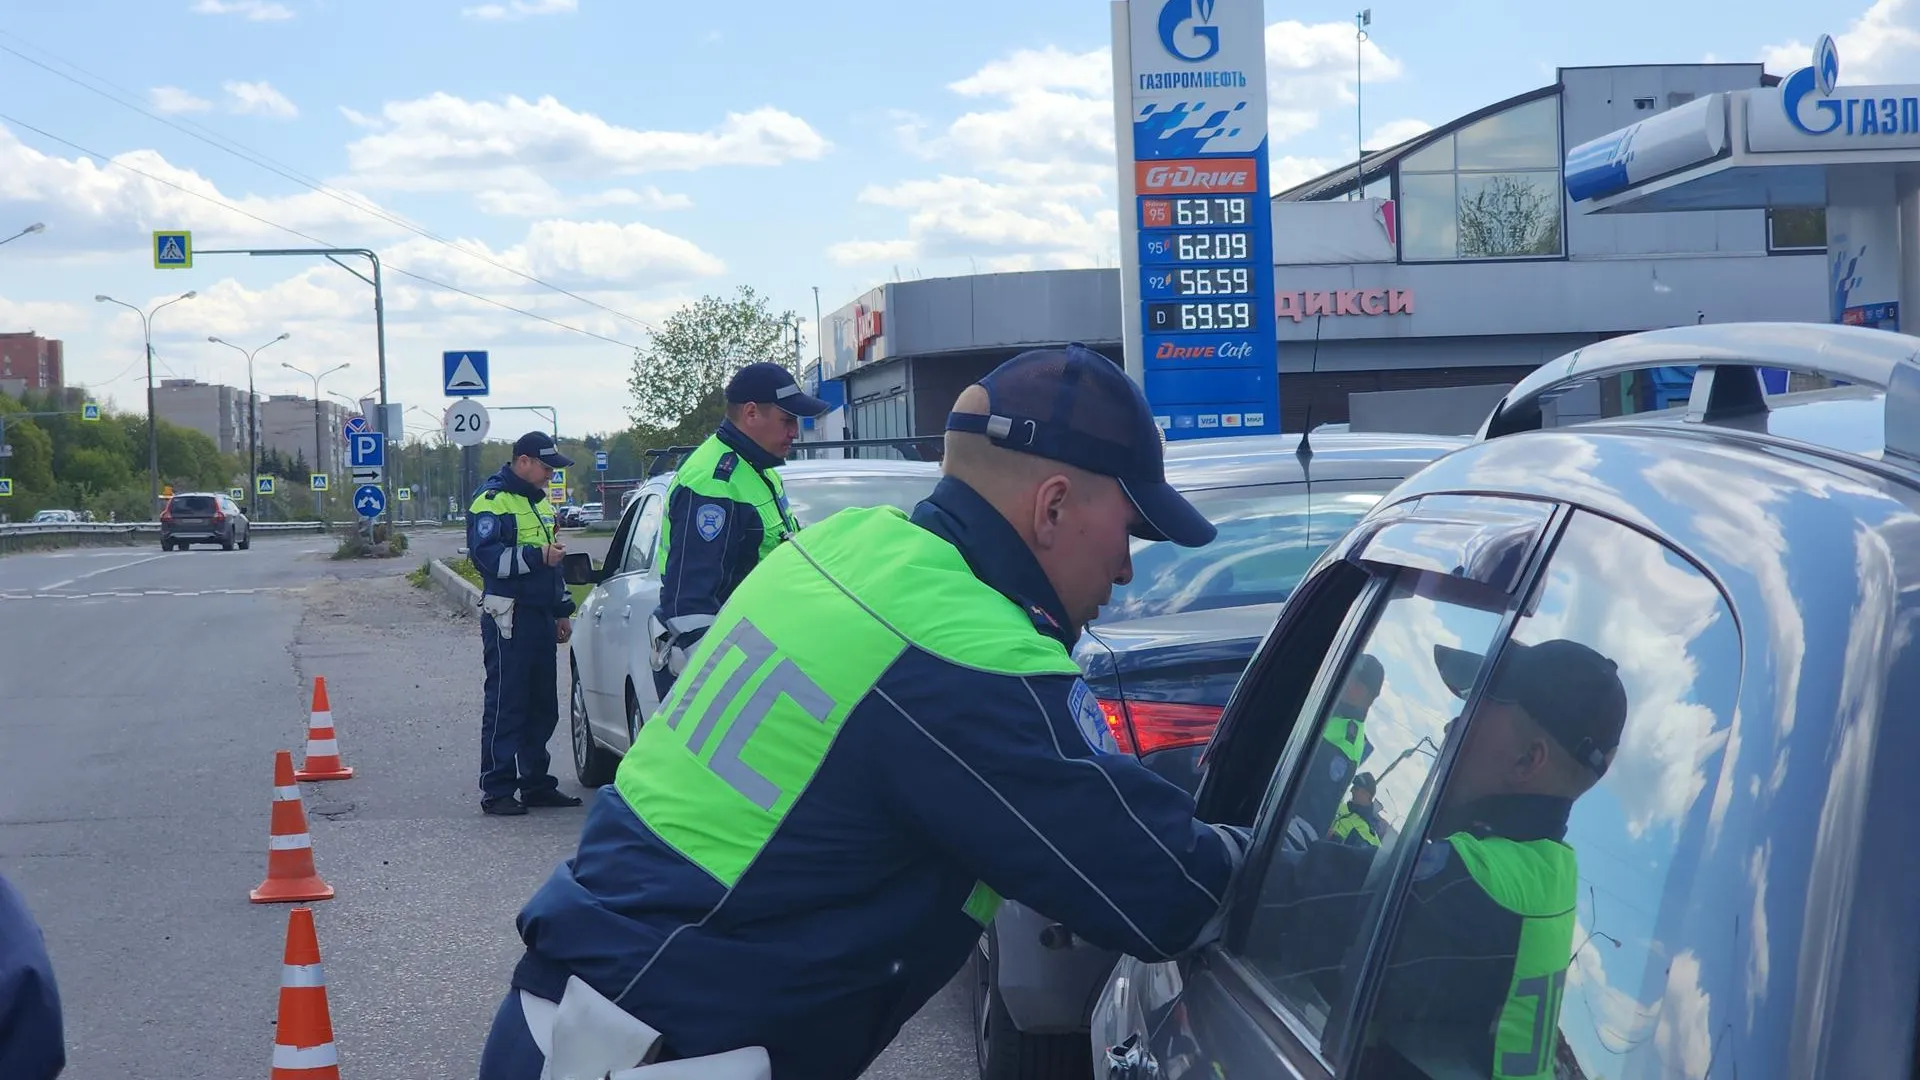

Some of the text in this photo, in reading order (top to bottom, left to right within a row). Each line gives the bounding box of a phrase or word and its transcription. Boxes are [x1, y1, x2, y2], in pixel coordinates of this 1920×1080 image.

[1139, 71, 1247, 90] ГАЗПРОМНЕФТЬ
[1845, 97, 1918, 136] ГАЗП
[1150, 199, 1245, 225] 95 63.79
[1148, 234, 1247, 260] 95 62.09
[1149, 268, 1248, 295] 92 56.59
[1157, 303, 1249, 330] D 69.59
[1218, 341, 1253, 360] Cafe
[454, 413, 481, 433] 20
[1201, 417, 1217, 425] VISA
[357, 437, 376, 463] P
[655, 616, 837, 812] ПС
